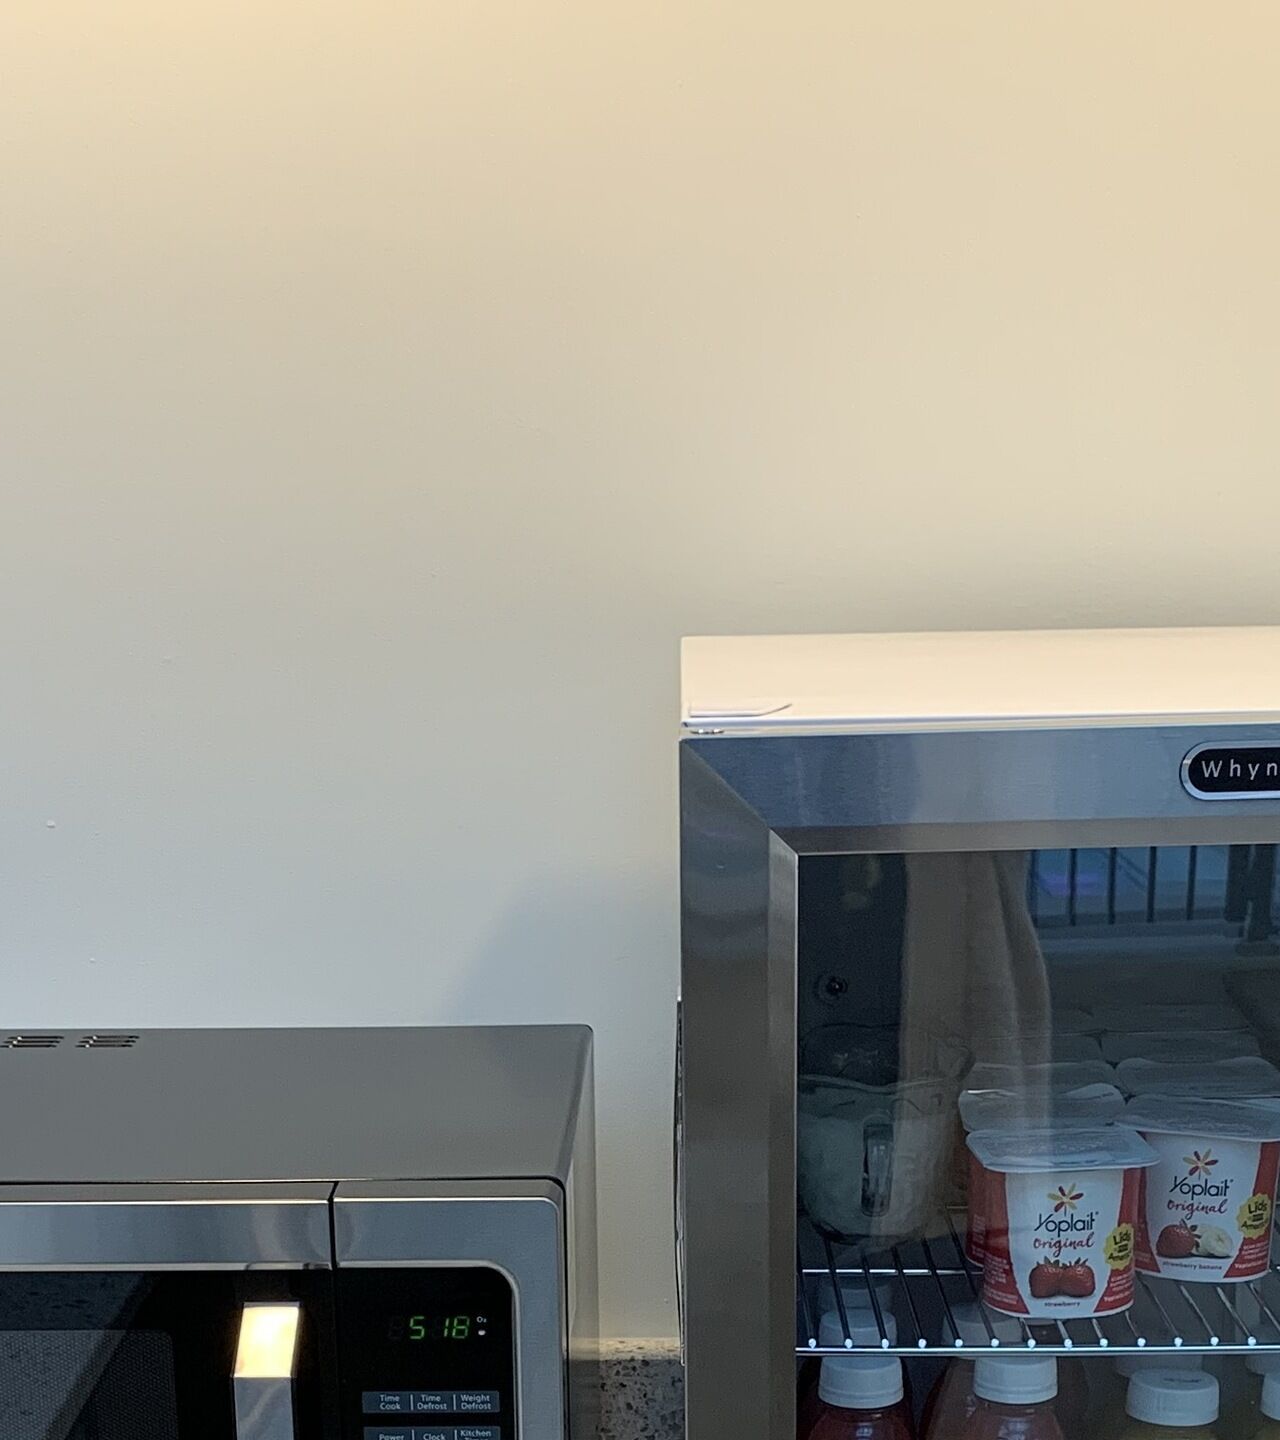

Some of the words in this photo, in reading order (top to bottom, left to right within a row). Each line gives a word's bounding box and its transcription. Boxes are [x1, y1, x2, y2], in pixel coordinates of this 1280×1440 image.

[1169, 1175, 1230, 1201] Yoplait
[1167, 1199, 1228, 1220] Original
[1248, 1202, 1267, 1215] Lids
[1034, 1213, 1096, 1238] Yoplait
[1033, 1232, 1095, 1257] Original
[379, 1394, 401, 1402] Time
[421, 1394, 442, 1402] Time
[460, 1394, 490, 1403] Weight
[379, 1402, 401, 1410] Cook
[417, 1402, 448, 1410] Defrost
[460, 1402, 492, 1410] Defrost
[379, 1433, 405, 1440] Power
[423, 1432, 446, 1440] Clock
[460, 1429, 492, 1437] Kitchen
